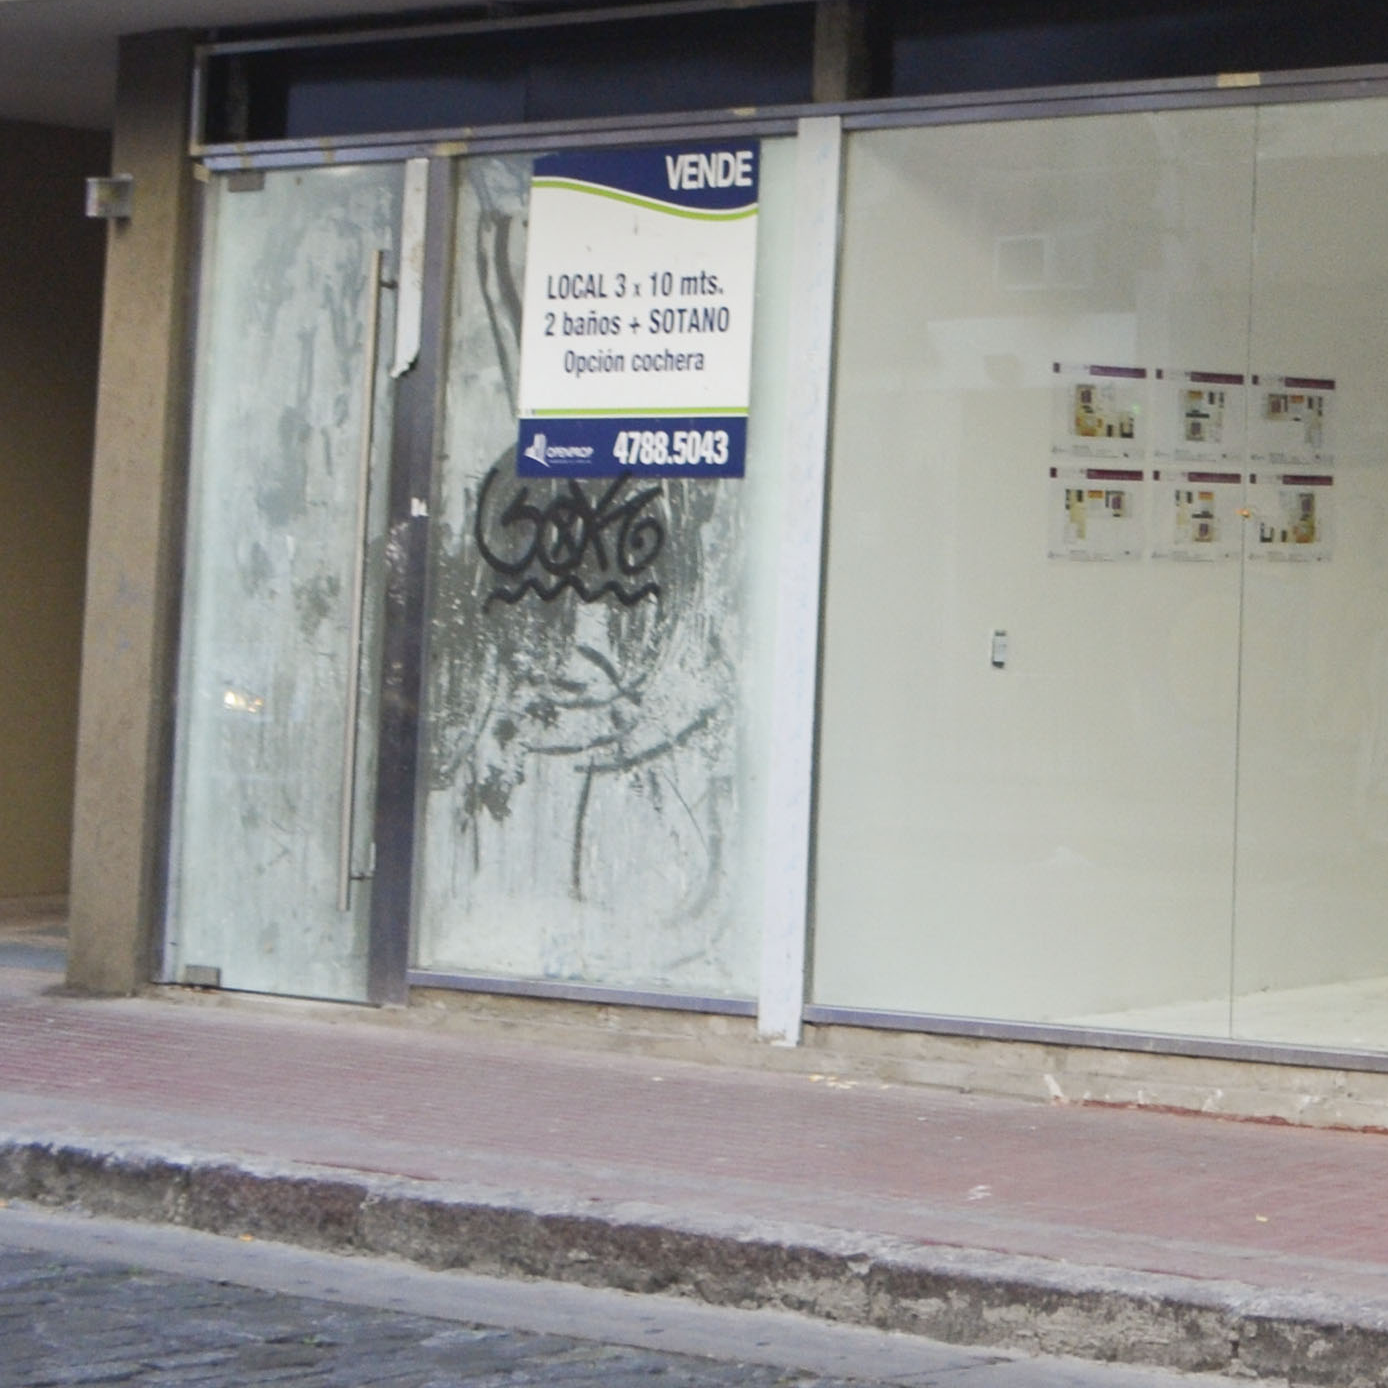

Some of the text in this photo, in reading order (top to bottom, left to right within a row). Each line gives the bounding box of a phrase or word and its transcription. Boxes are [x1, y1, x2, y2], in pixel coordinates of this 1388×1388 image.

[665, 150, 754, 191] VENDE
[547, 271, 724, 301] LOCAL 3 x 10 mts.
[544, 313, 556, 337] 2
[562, 311, 621, 336] baños
[648, 307, 730, 335] SOTANO
[564, 349, 705, 379] Opción cochera
[612, 430, 729, 465] 4788.5043
